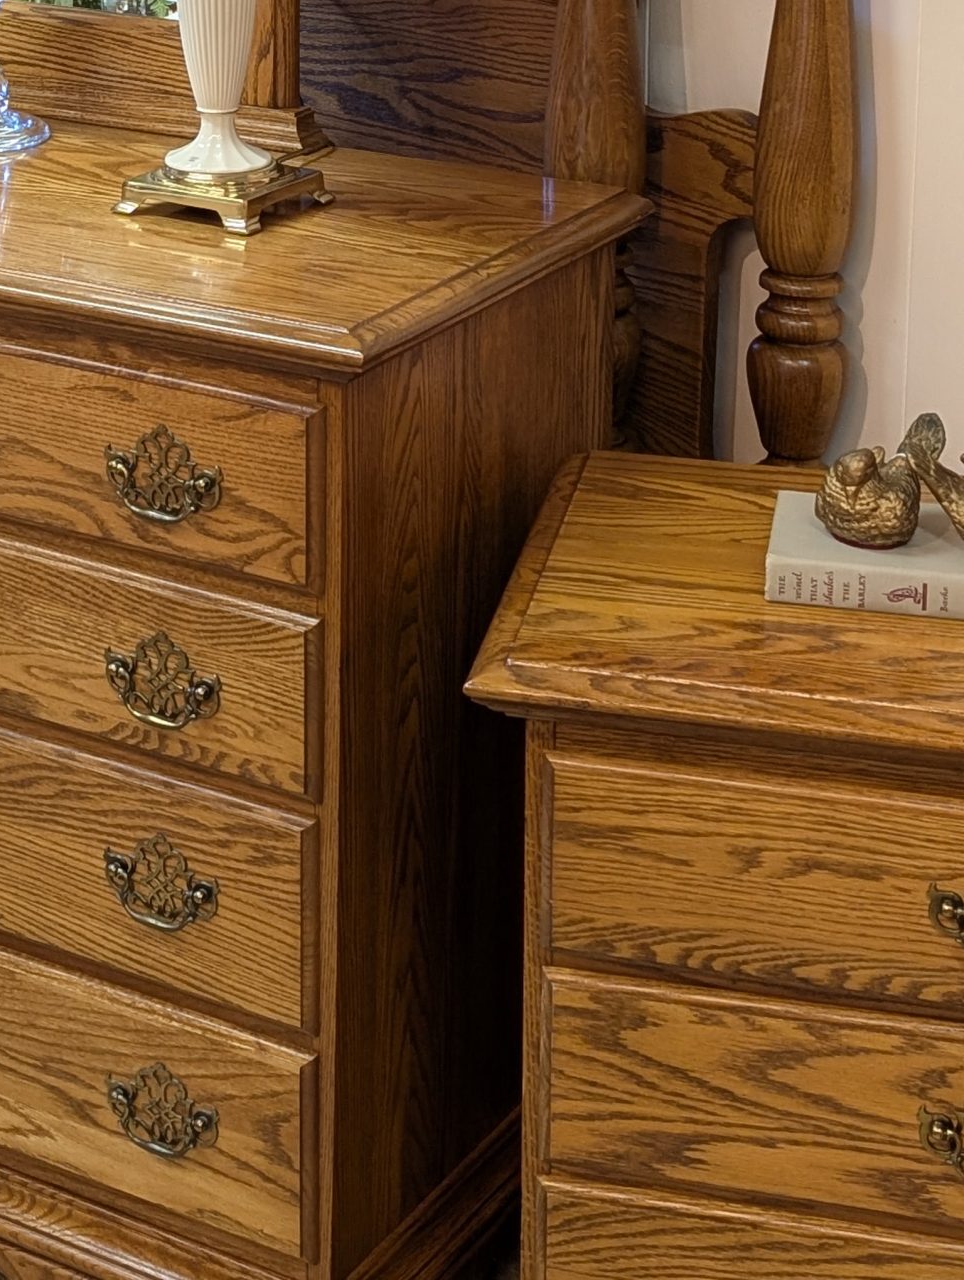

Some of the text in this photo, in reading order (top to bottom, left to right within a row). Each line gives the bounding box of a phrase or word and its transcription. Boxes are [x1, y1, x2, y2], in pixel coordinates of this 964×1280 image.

[778, 575, 786, 596] THE
[791, 571, 803, 601] wind
[810, 577, 818, 603] THAT
[822, 570, 835, 606] shakes
[842, 581, 850, 602] THE
[857, 573, 867, 609] BARLEY
